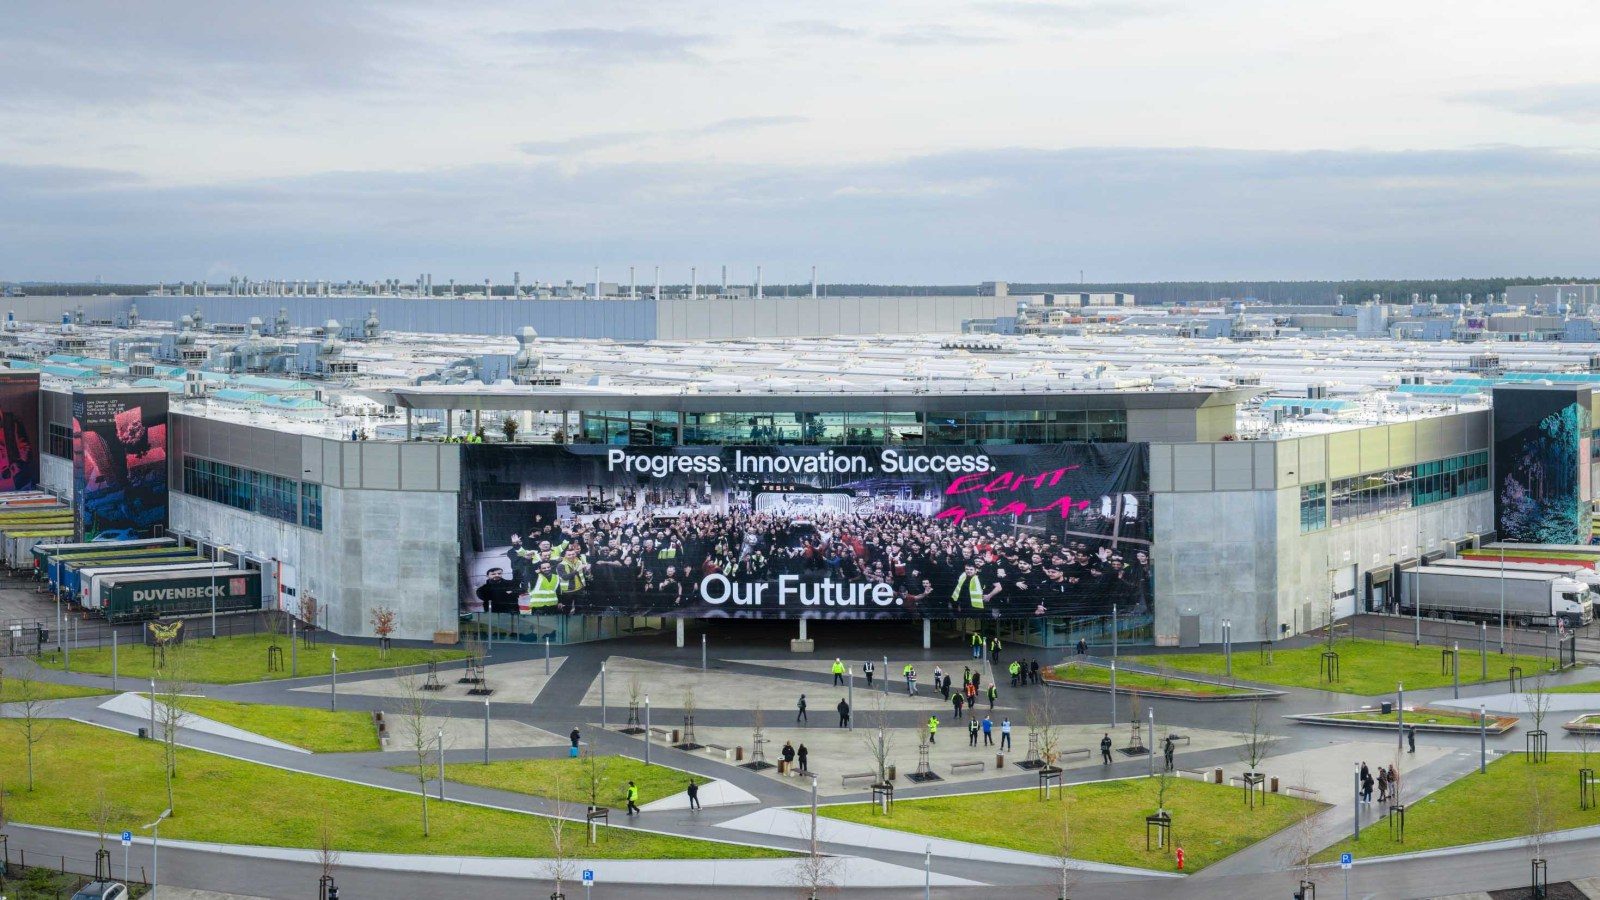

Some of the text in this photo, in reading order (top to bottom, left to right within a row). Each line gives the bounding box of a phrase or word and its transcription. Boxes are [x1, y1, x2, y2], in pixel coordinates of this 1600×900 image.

[608, 449, 996, 478] Progress. Innovation. Success.
[132, 585, 226, 602] DUVENBECK
[700, 572, 904, 606] Our Future.
